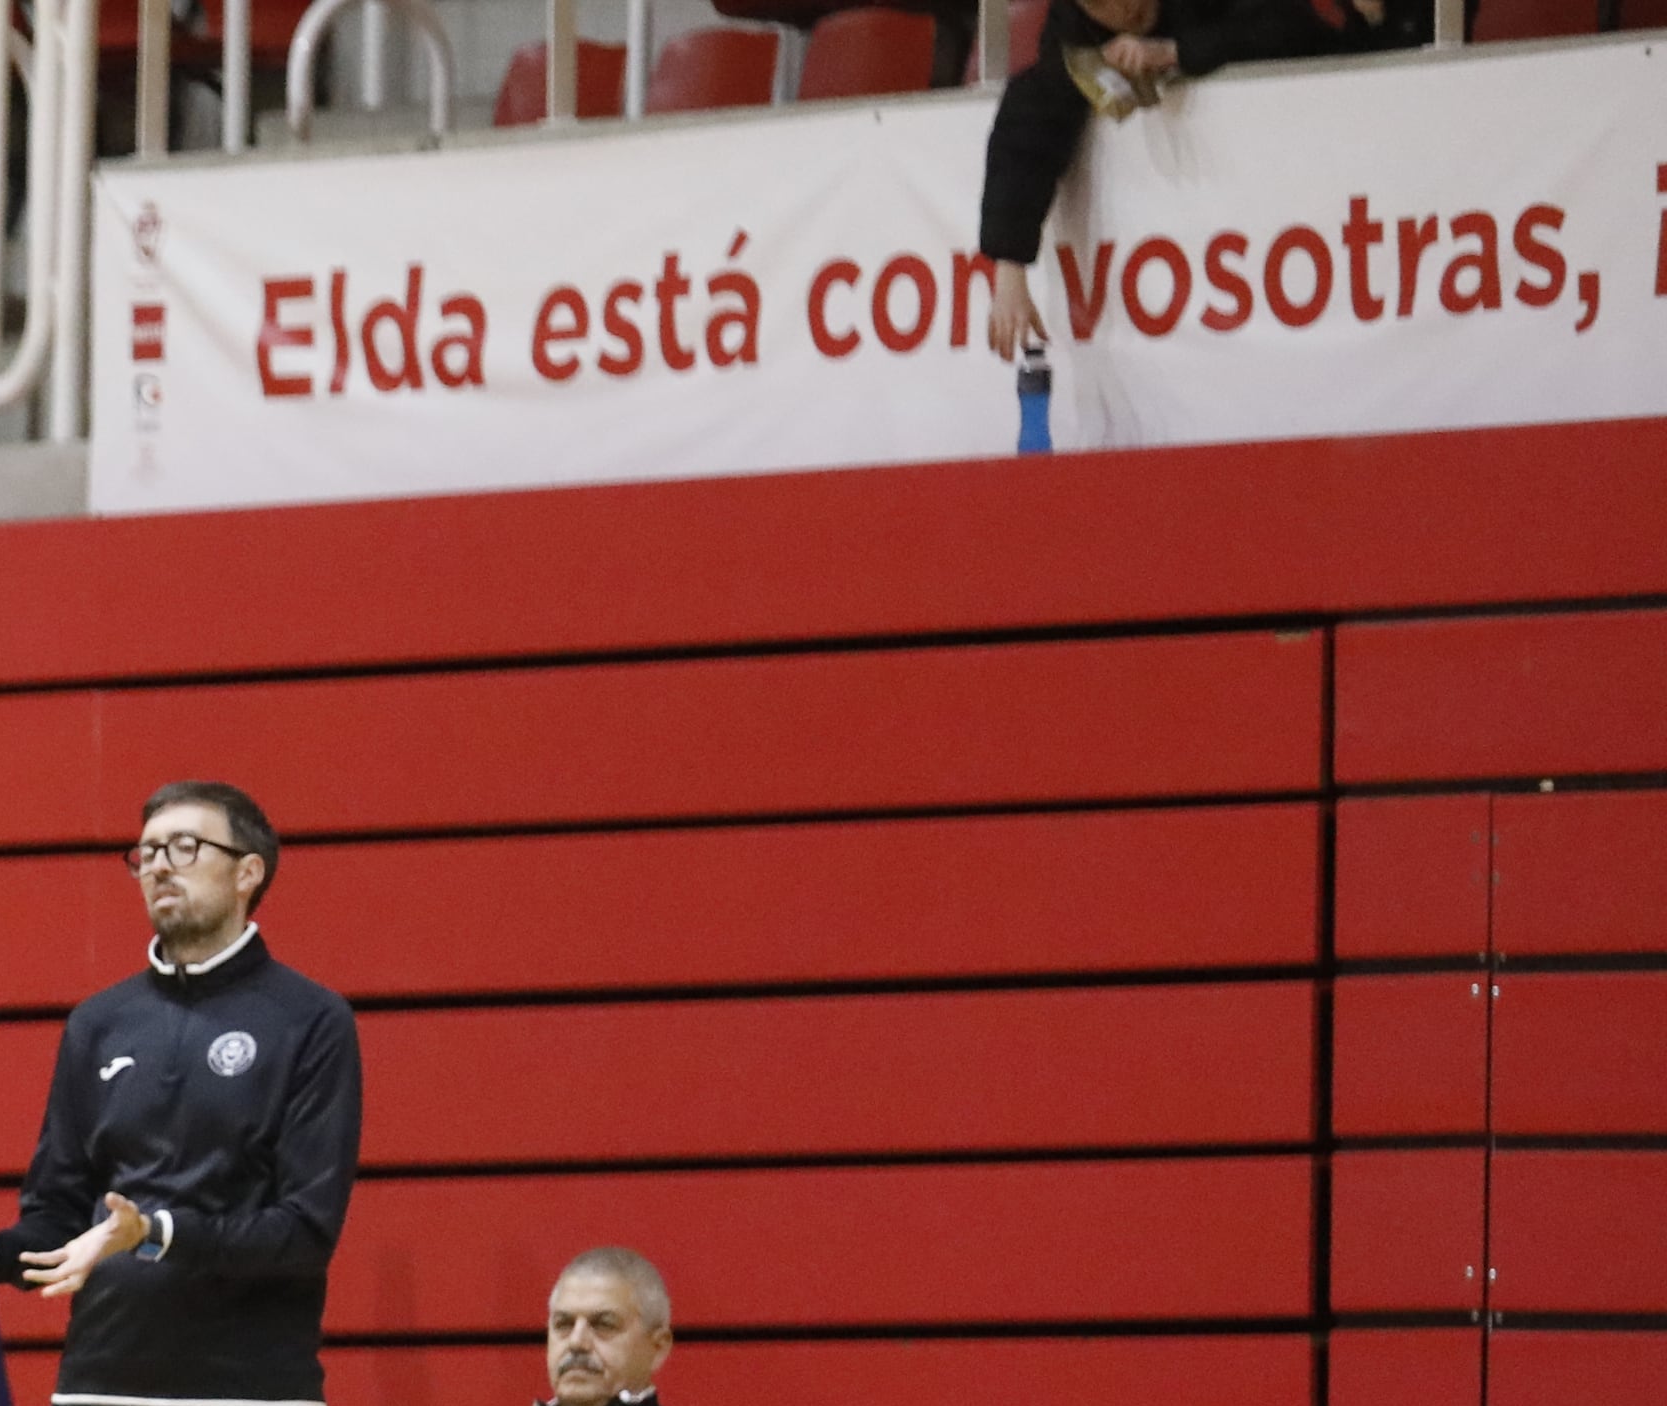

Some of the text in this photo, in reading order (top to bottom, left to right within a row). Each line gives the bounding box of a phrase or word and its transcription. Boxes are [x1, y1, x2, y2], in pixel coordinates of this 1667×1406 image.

[258, 263, 487, 398] Elda
[532, 228, 762, 382] está
[1057, 194, 1601, 342] vosotras,
